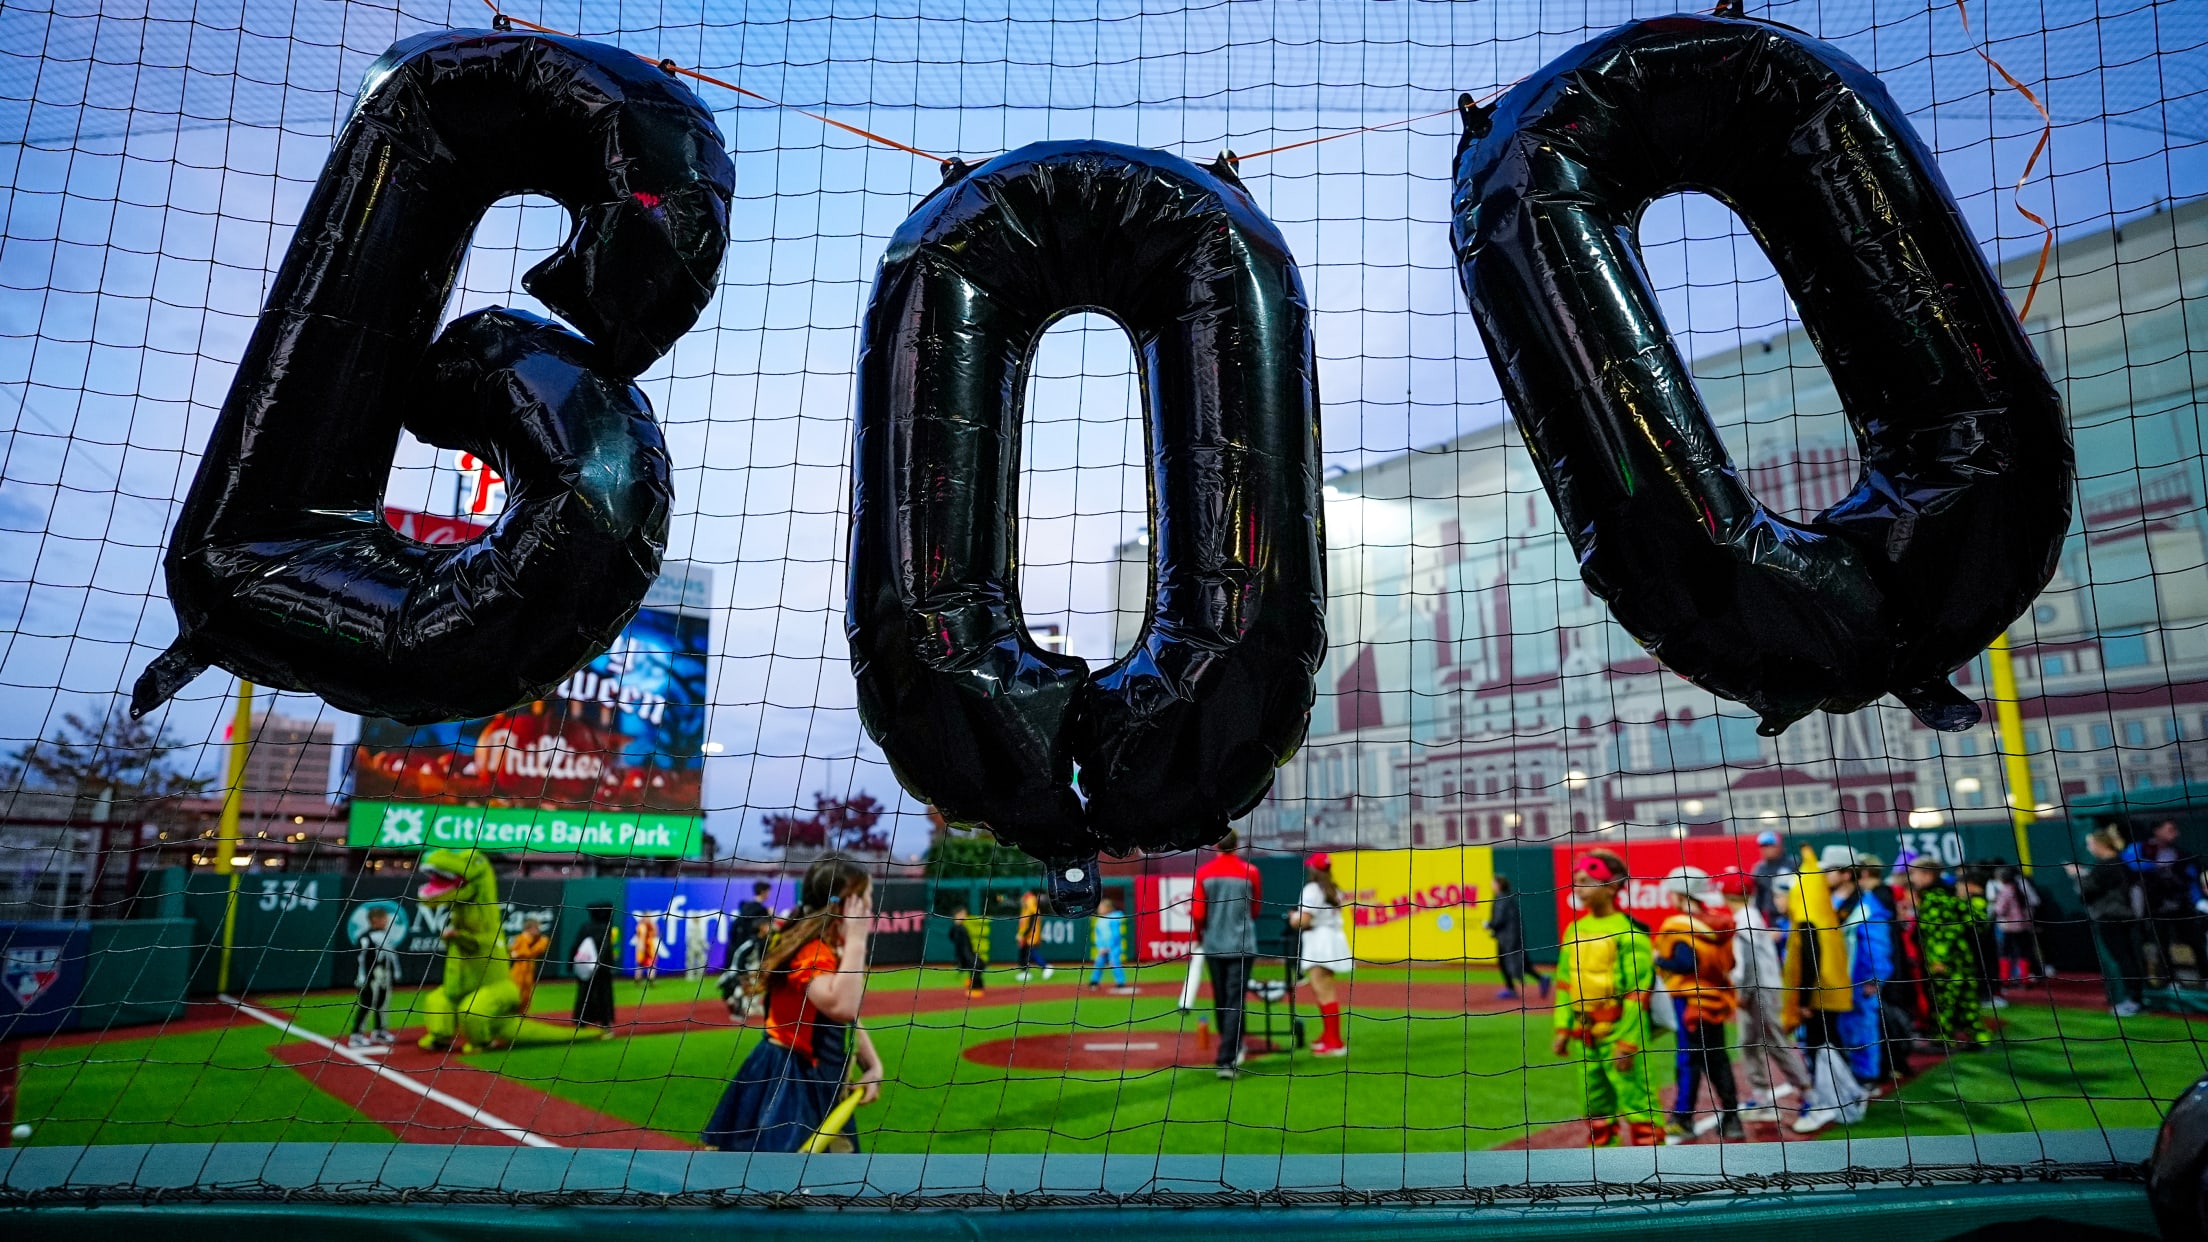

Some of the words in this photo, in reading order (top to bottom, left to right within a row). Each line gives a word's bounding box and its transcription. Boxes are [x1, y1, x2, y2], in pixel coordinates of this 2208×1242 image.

[484, 727, 604, 781] Phillies
[434, 815, 545, 845] Citizens
[551, 821, 614, 846] Bank
[619, 825, 671, 847] Park
[259, 880, 319, 911] 334
[1041, 920, 1075, 944] 401
[1148, 940, 1197, 960] TOY
